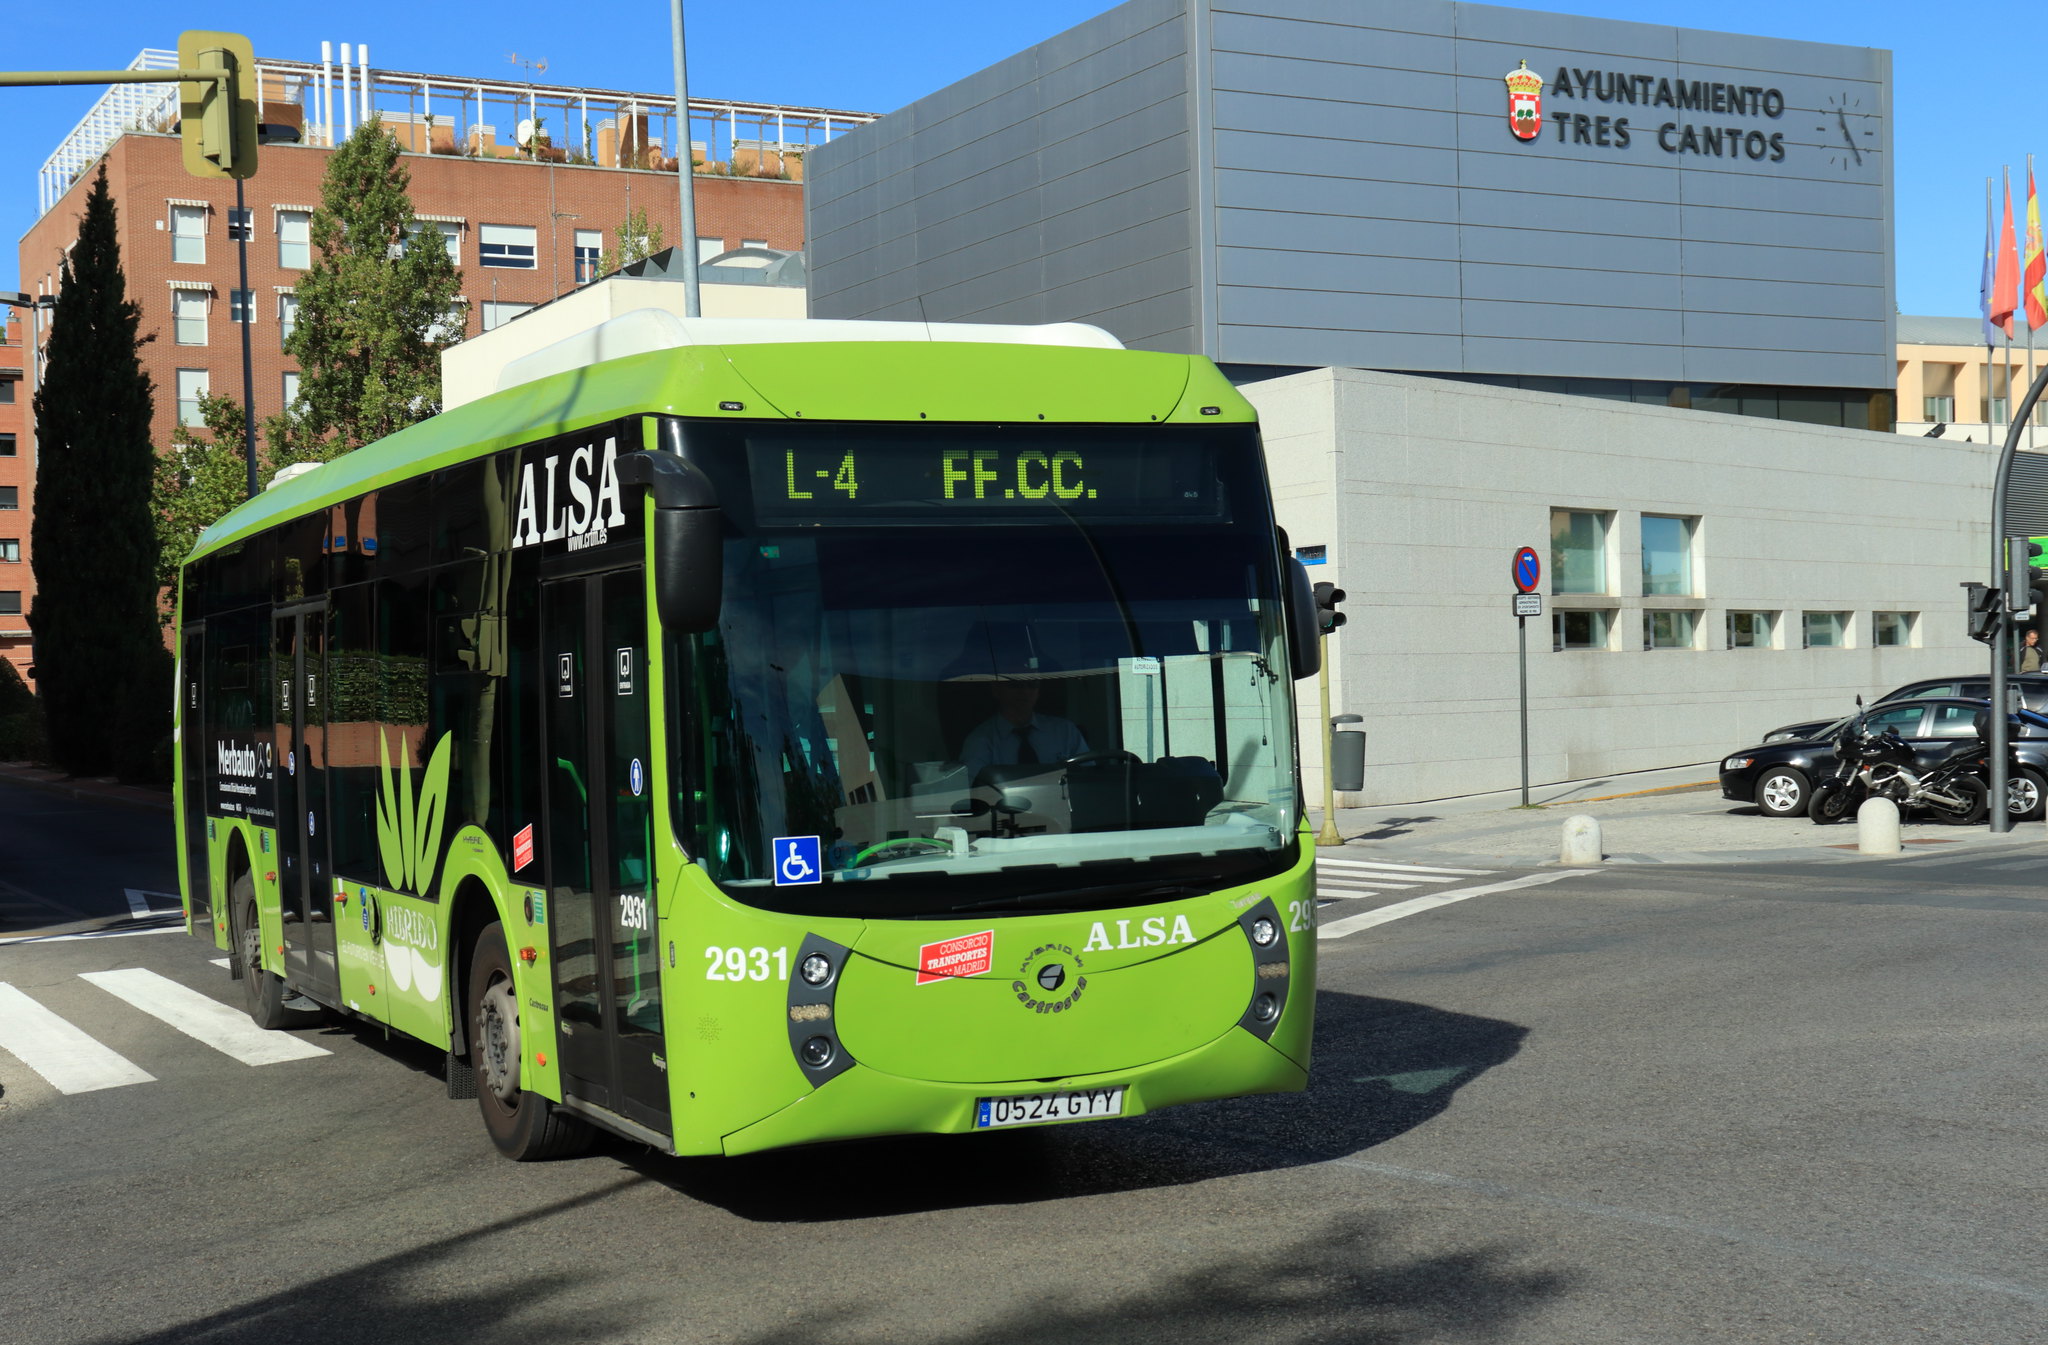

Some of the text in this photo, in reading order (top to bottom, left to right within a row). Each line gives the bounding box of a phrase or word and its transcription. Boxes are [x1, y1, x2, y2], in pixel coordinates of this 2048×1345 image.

[1551, 67, 1785, 118] AYUNTAMIENTO
[1551, 112, 1786, 162] TRES CANTOS
[512, 437, 626, 549] ALSA
[786, 449, 1098, 500] L-4 FF.CC.
[217, 739, 256, 778] Merbauto
[620, 894, 647, 931] 2931
[939, 935, 989, 956] CONSORCIO
[1083, 914, 1197, 952] ALSA
[705, 946, 787, 982] 2931
[927, 947, 988, 970] TRANSPORTES
[953, 959, 987, 977] MADRID
[1012, 975, 1088, 1014] Castrosua
[981, 1088, 1116, 1122] E 0524 GYY
